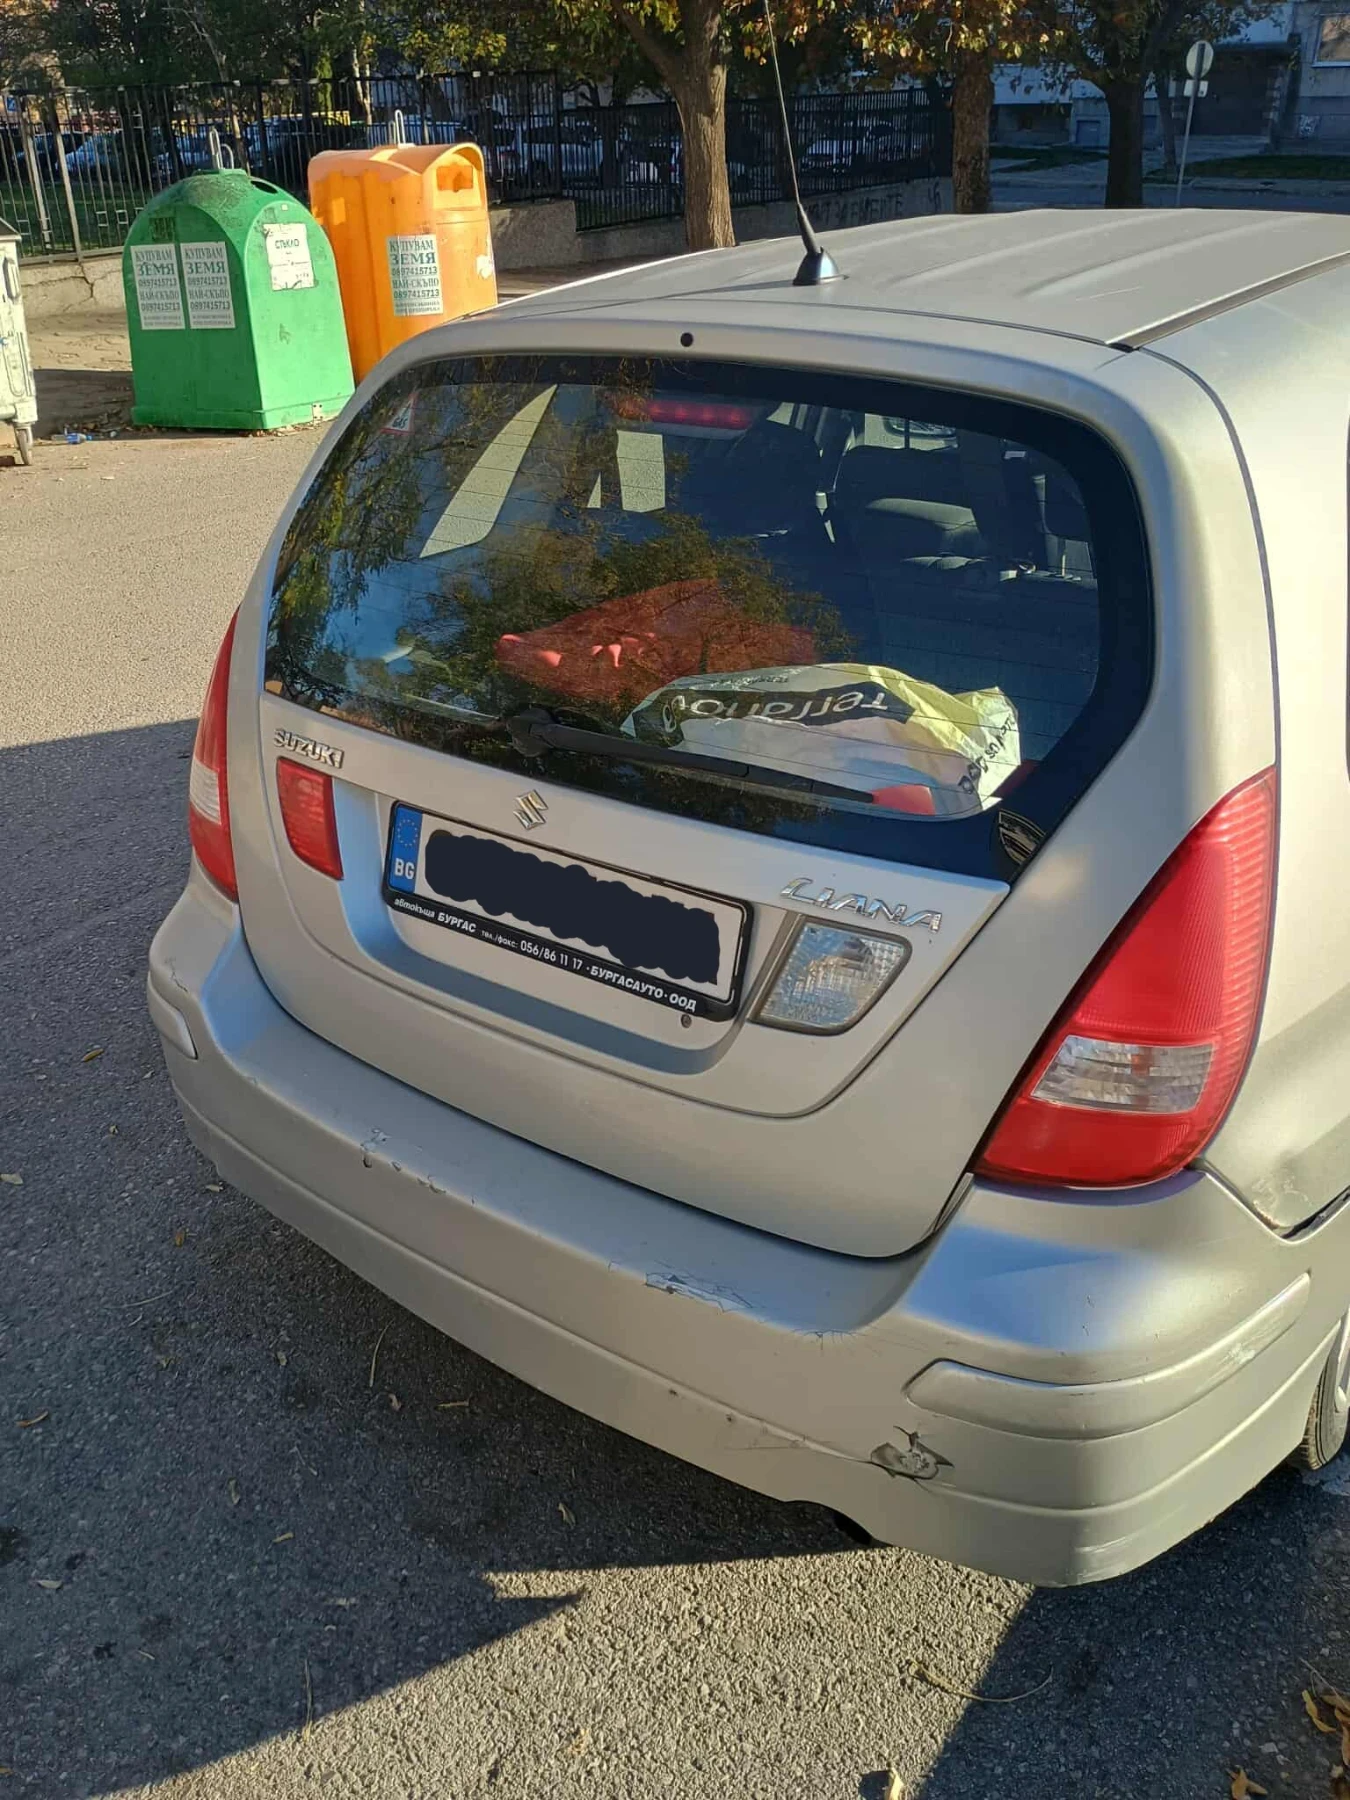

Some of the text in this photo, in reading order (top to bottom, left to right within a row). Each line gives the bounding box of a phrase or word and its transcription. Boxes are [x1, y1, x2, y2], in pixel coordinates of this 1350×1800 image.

[388, 240, 433, 252] КУПУВАМ
[135, 249, 173, 261] КУПУВАМ
[184, 247, 223, 260] КУПУВАМ
[390, 252, 436, 265] ЗЕМЯ
[139, 262, 175, 276] ЗЕМЯ
[187, 261, 226, 275] ЗЕМЯ
[394, 289, 440, 299] 0897415713
[190, 300, 231, 311] 0897415713
[274, 728, 345, 769] SUZUKI
[394, 857, 415, 880] BG
[780, 877, 943, 934] LIANA
[394, 898, 435, 918] автокъща
[437, 912, 477, 933] БУРГАС
[520, 940, 556, 962] 056/86
[560, 953, 568, 966] 11
[573, 957, 583, 970] 17
